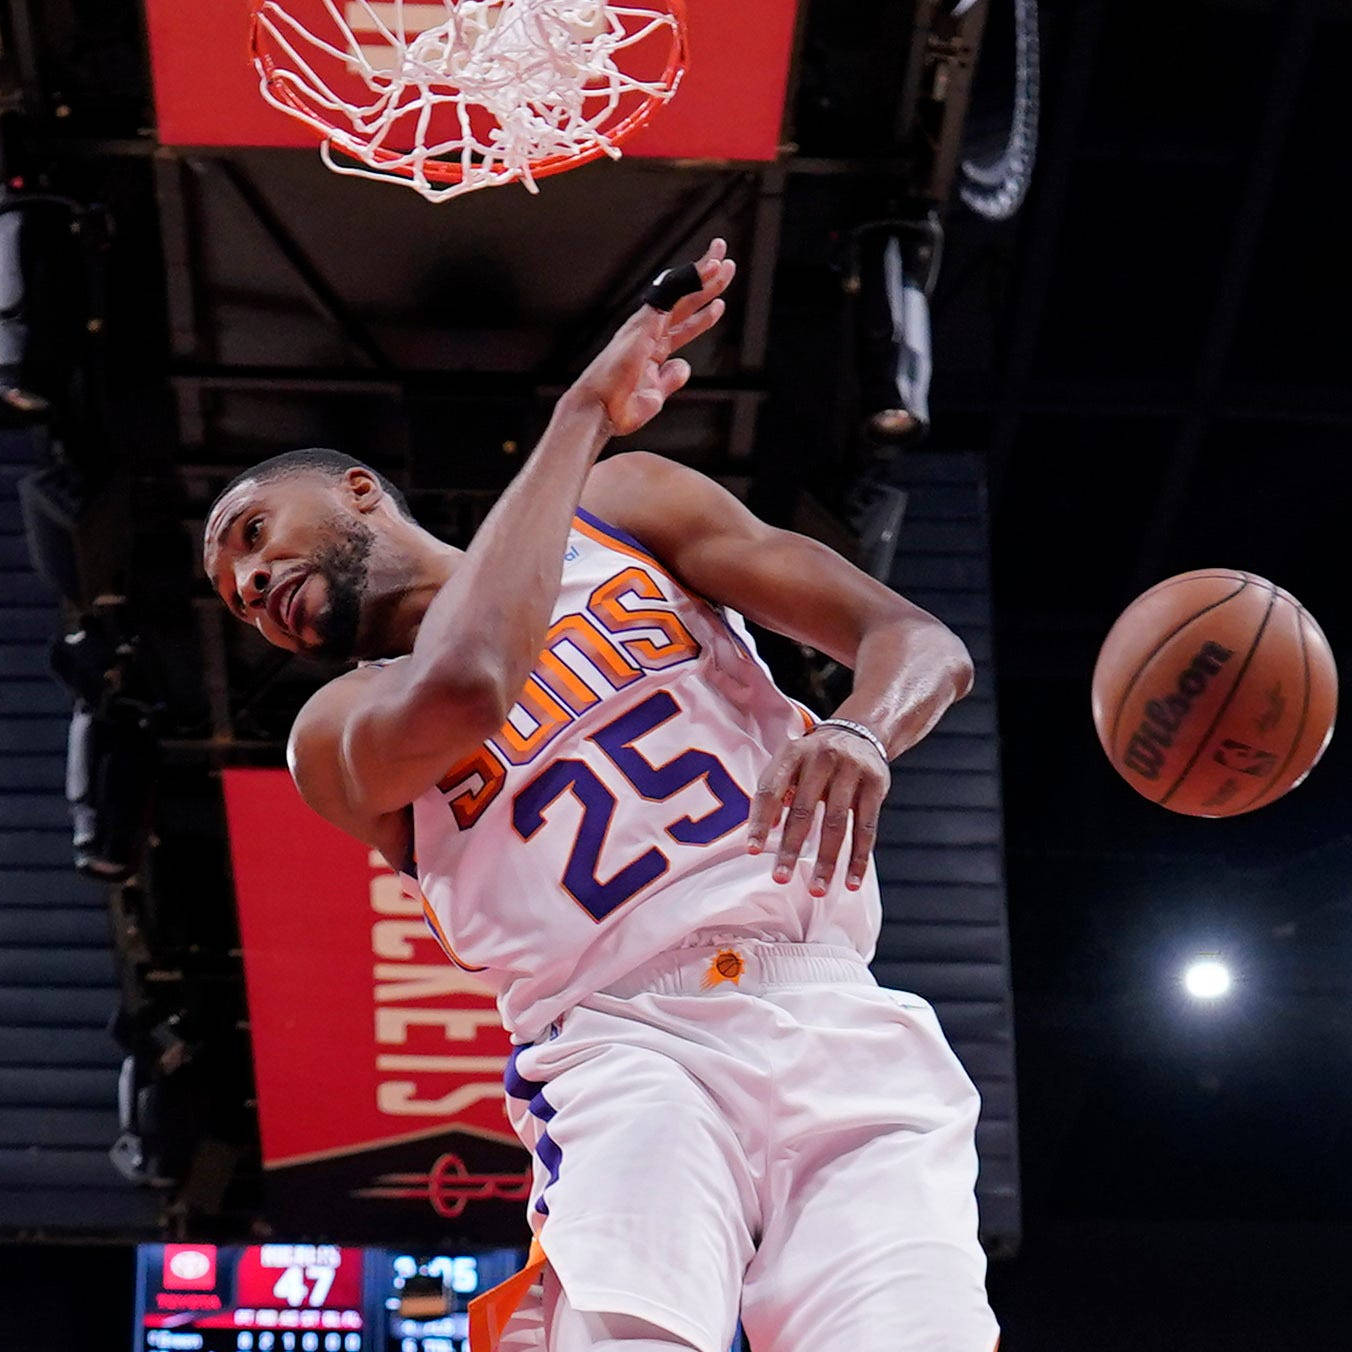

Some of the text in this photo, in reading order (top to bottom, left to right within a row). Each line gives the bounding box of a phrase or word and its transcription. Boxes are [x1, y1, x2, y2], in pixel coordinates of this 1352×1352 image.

[1123, 640, 1234, 781] Wilson
[511, 688, 751, 925] 25
[272, 1265, 337, 1307] 47
